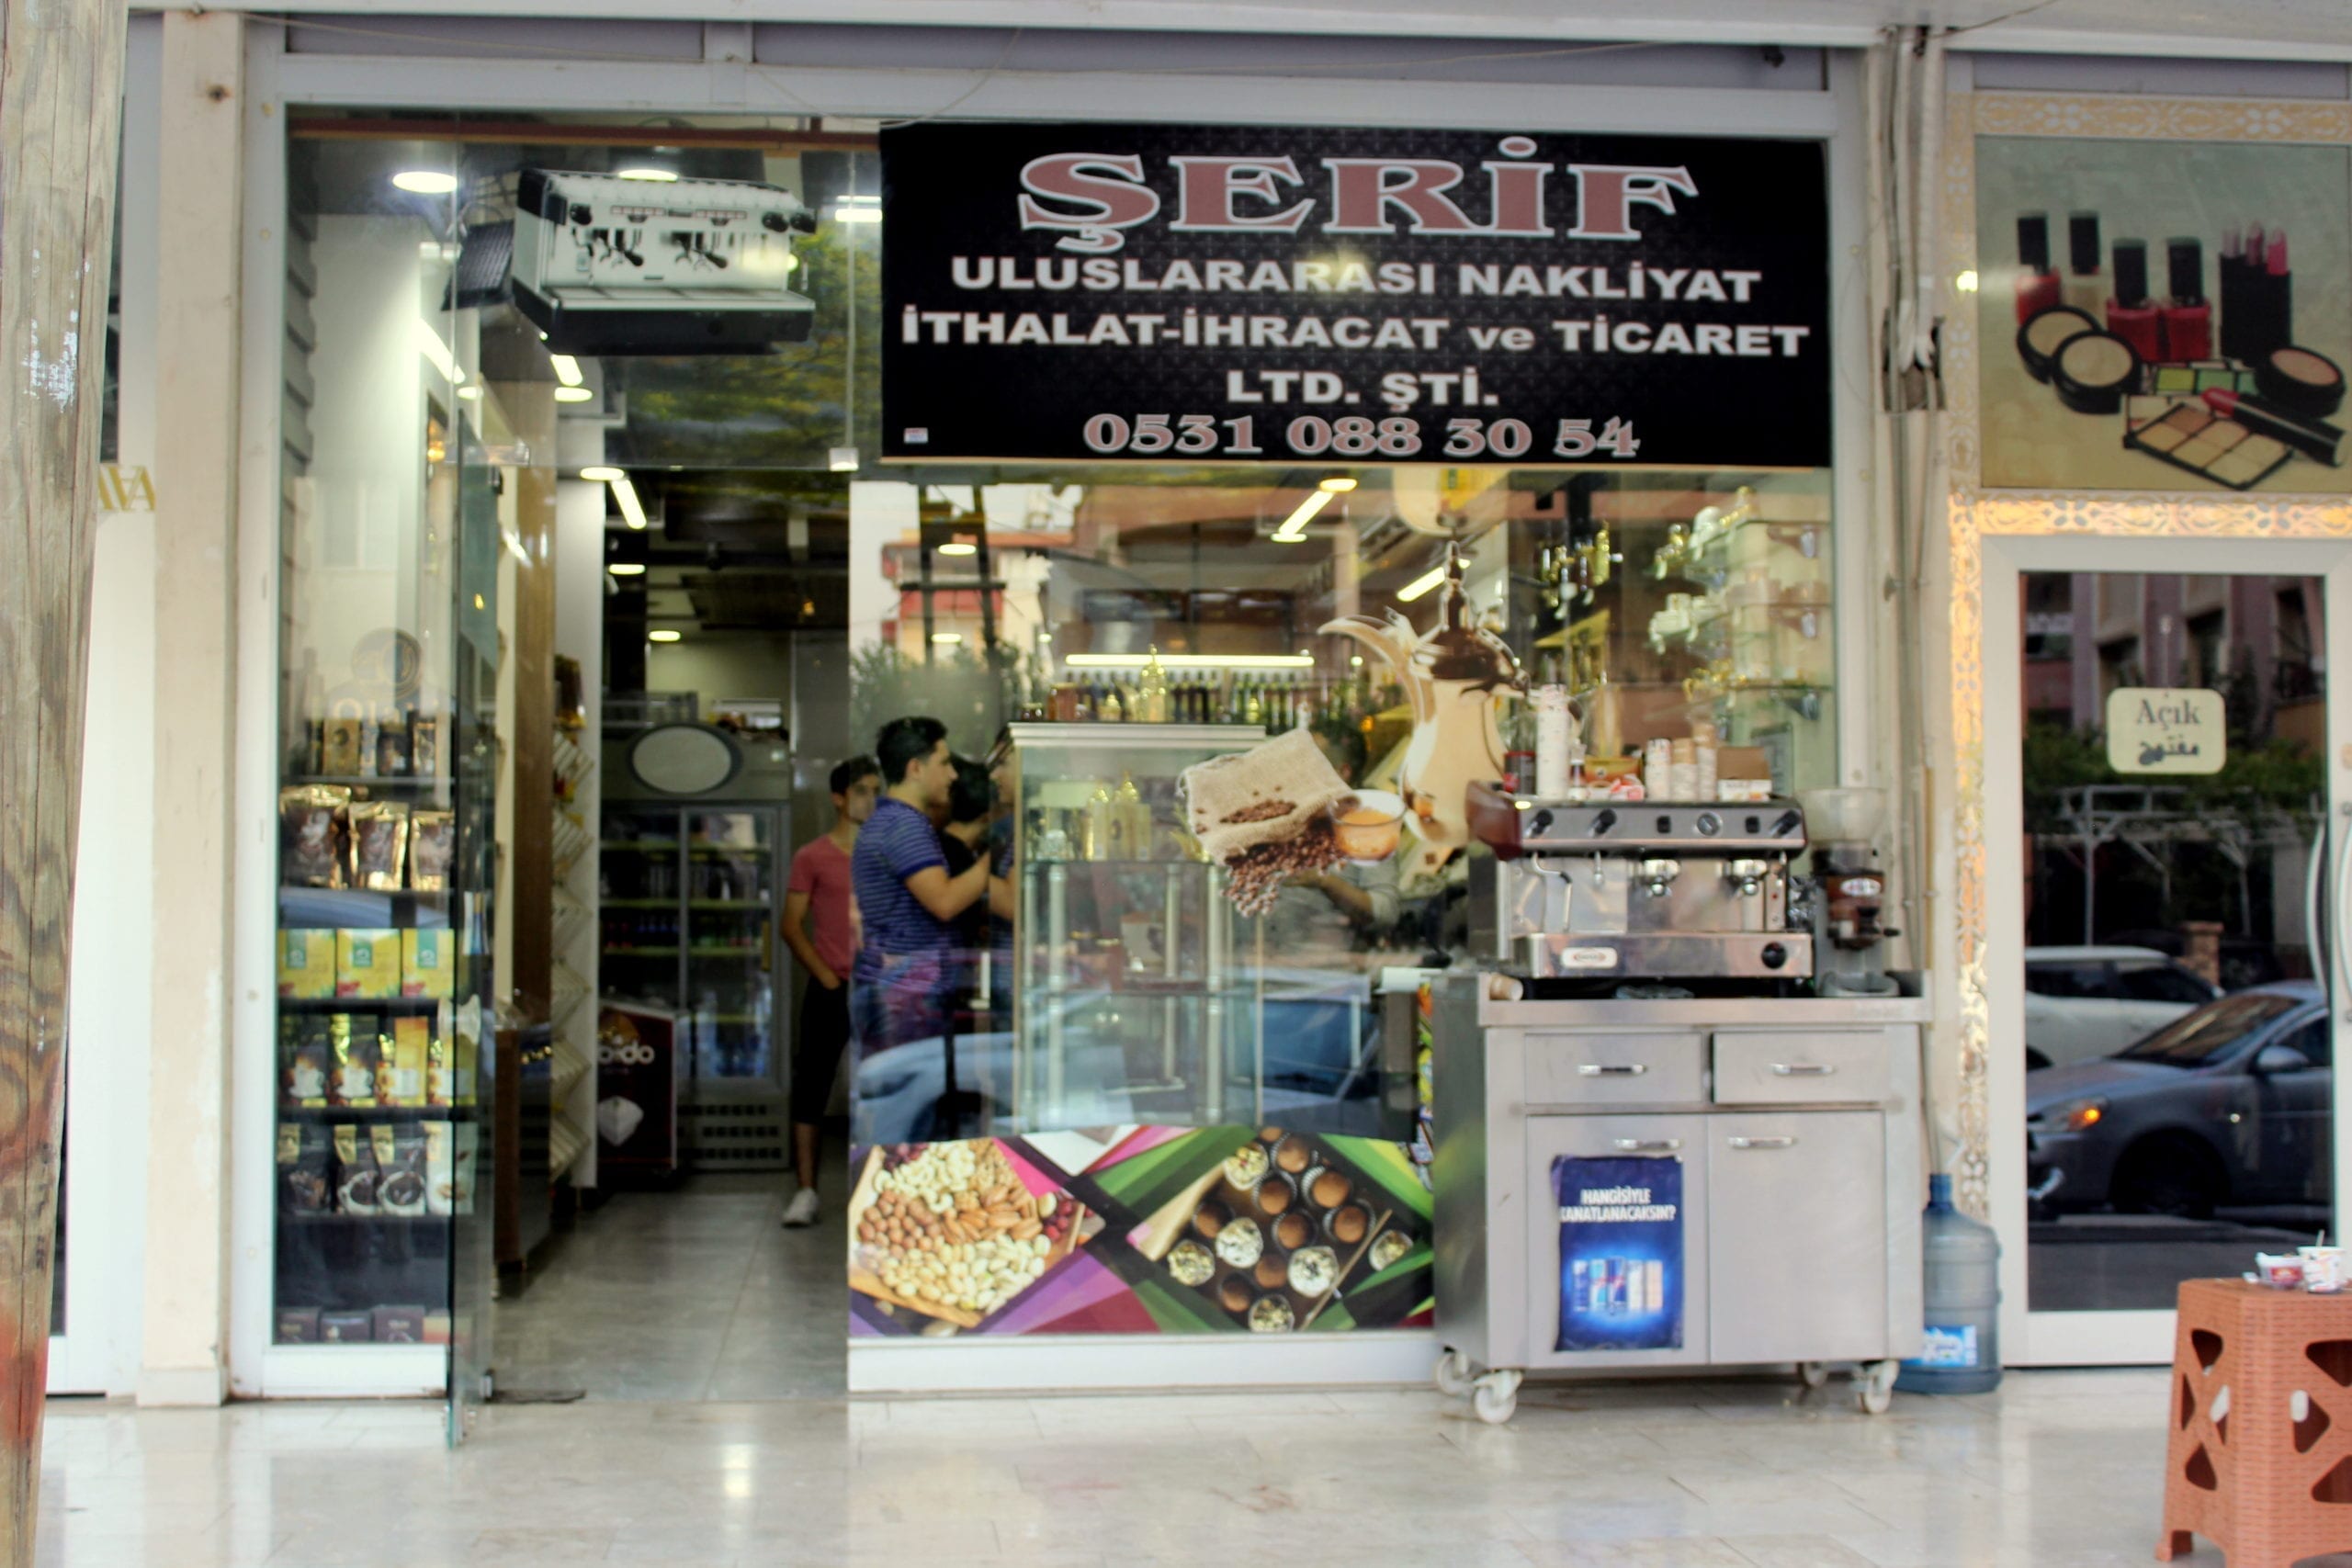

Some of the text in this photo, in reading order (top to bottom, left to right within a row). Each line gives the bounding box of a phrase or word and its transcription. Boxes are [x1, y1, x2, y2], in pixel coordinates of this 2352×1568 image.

[1017, 136, 1699, 254] ŞERİF
[951, 256, 1762, 302] ULUSLARARASI NAKLİYAT
[902, 304, 1810, 356] İTHALAT-İHRACAT ve TİCARET
[1227, 367, 1499, 412] LTD. ŞTİ.
[1083, 412, 1641, 458] 0531 088 30 54
[2136, 698, 2201, 730] Açık
